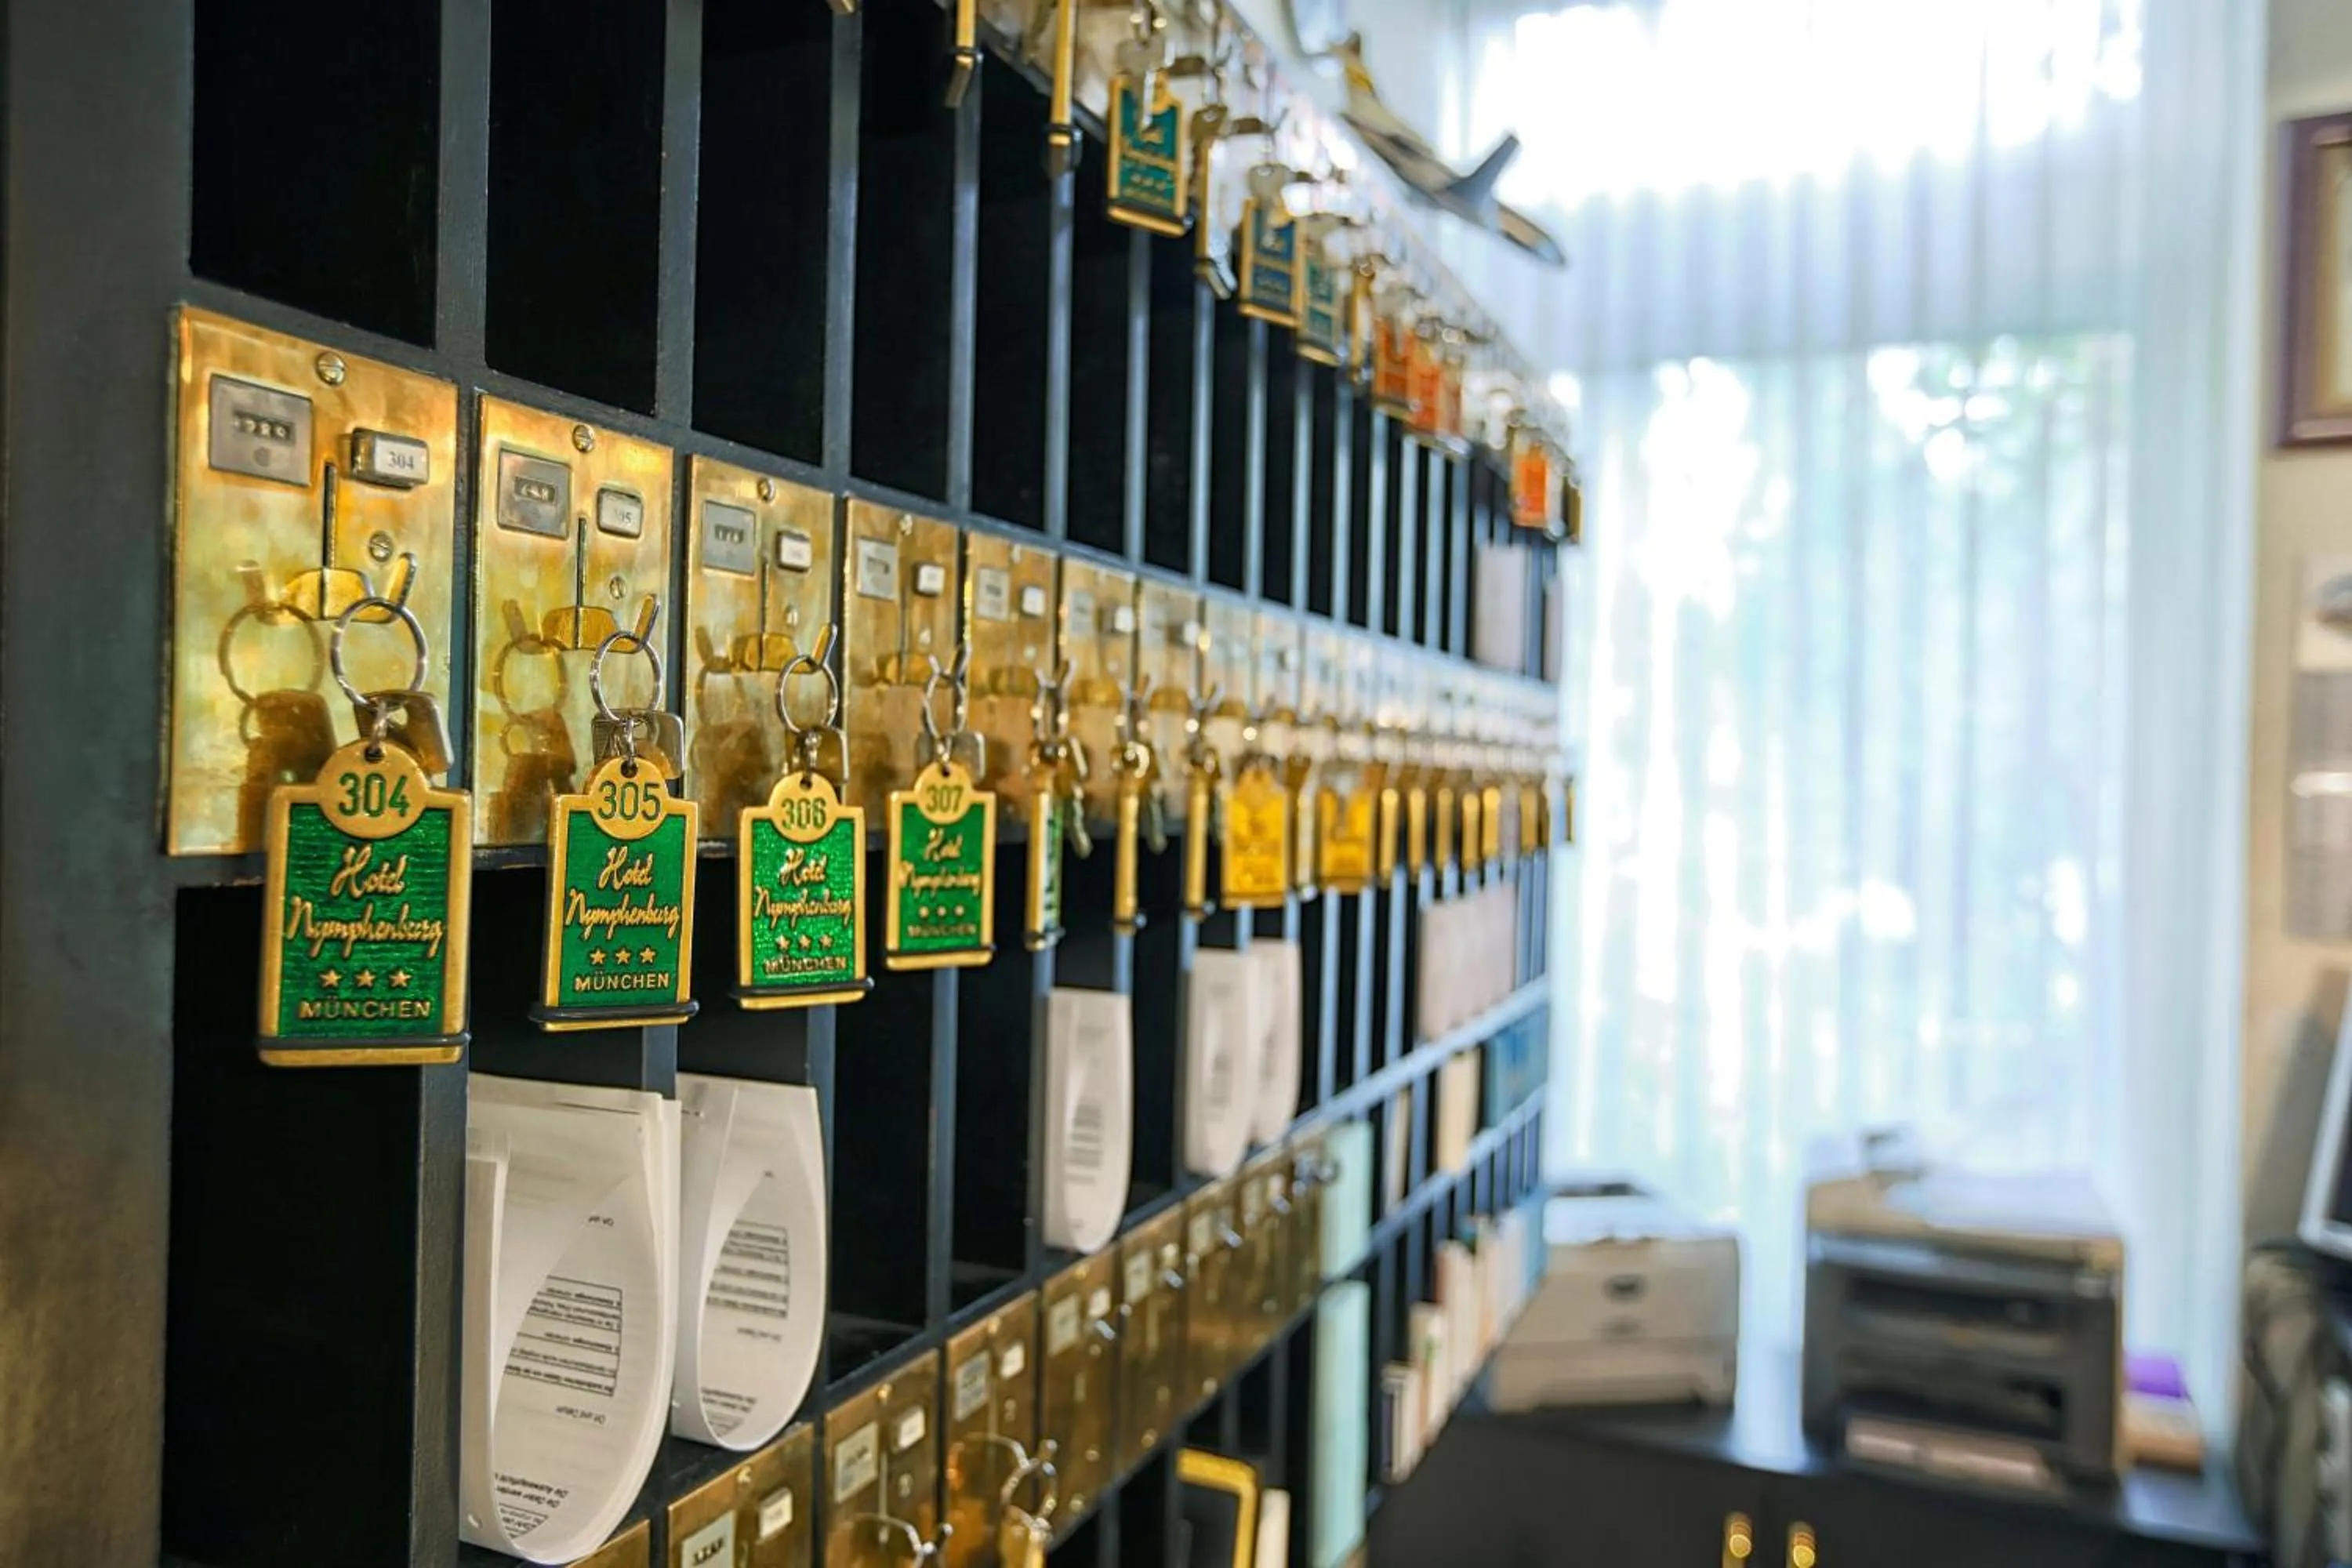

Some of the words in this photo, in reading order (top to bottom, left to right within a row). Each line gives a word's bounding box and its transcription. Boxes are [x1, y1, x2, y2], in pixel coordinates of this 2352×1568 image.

[387, 450, 414, 470] 304
[338, 772, 410, 817] 304
[597, 780, 661, 821] 305
[781, 797, 827, 829] 306
[924, 785, 964, 814] 307
[330, 843, 408, 898] Hotel
[597, 845, 653, 890] Hotel
[778, 847, 828, 887] Hotel
[565, 888, 681, 940] Nymphenburg
[754, 884, 851, 929] Nymphenburg
[286, 895, 445, 959] Nymphenburg
[574, 970, 669, 991] MÜNCHEN
[764, 953, 848, 974] MÜNCHEN
[299, 996, 431, 1020] MÜNCHEN
